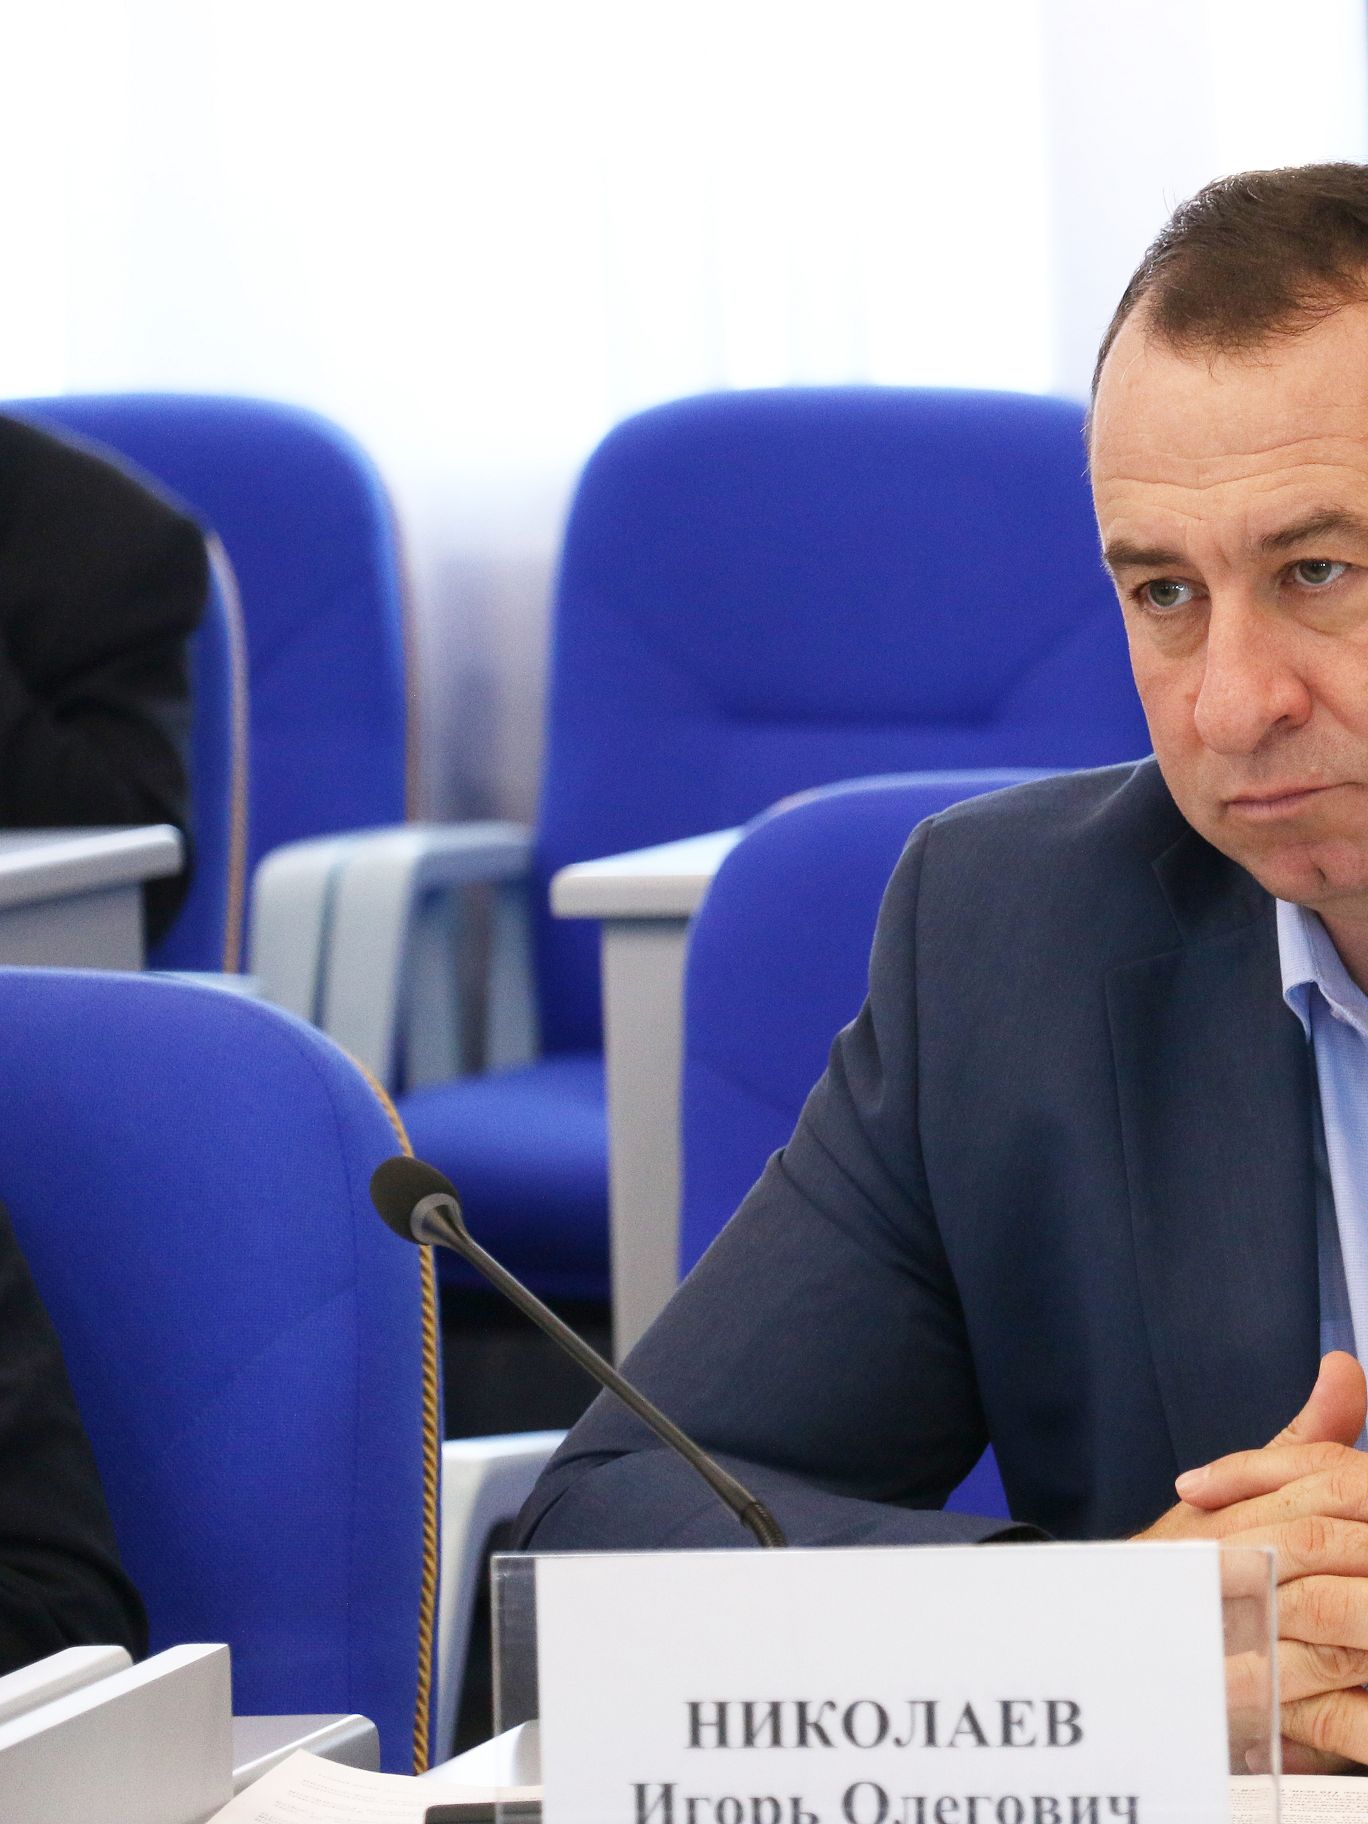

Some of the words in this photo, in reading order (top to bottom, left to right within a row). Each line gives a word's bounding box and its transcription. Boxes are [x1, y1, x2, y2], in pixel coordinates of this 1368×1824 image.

[684, 1699, 1084, 1749] НИКОЛАЕВ
[629, 1783, 820, 1824] Игорь
[841, 1781, 1140, 1824] Олегович
